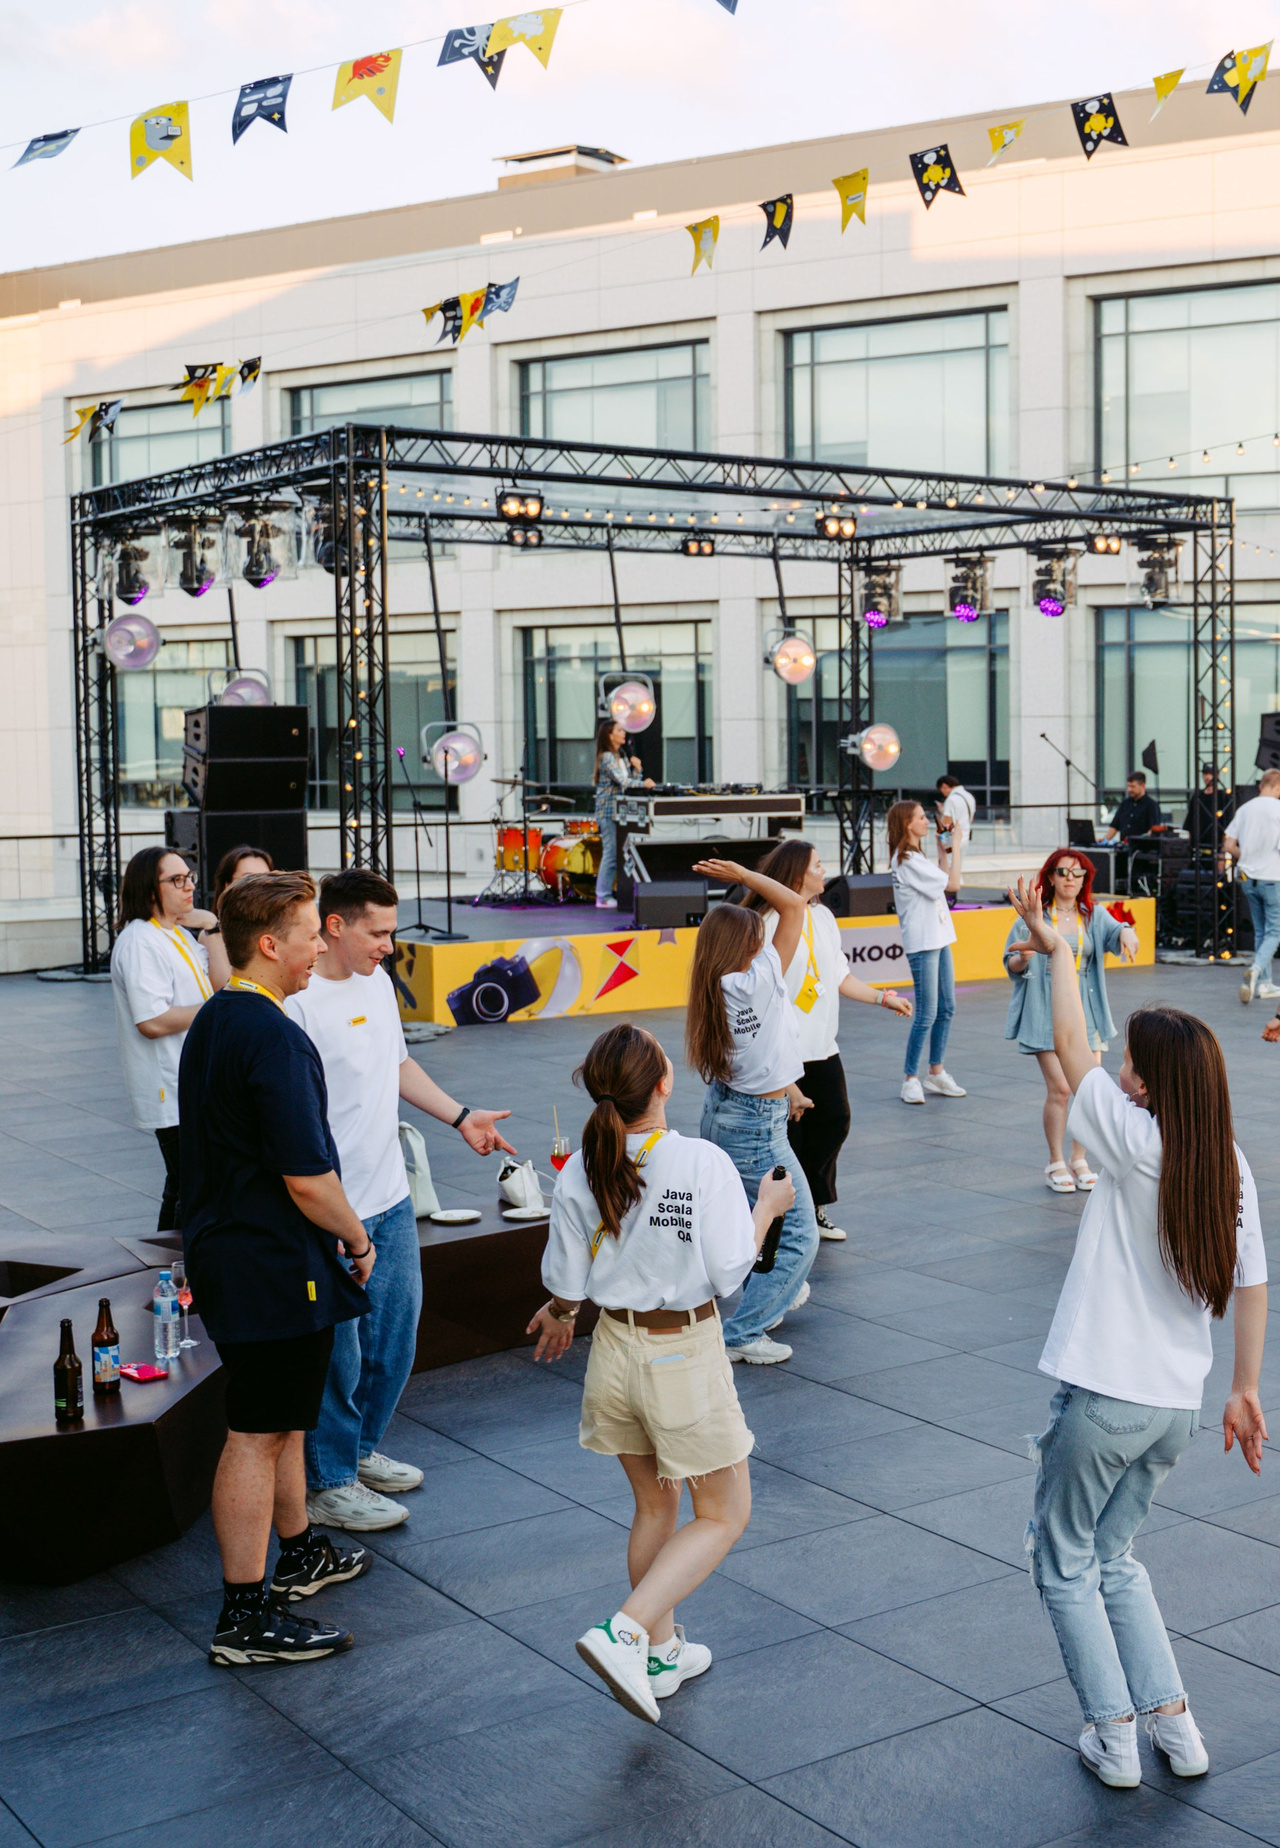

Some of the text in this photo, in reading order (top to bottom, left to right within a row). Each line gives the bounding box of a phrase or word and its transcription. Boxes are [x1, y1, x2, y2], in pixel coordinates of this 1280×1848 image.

[736, 1007, 754, 1017] Java
[736, 1015, 758, 1026] Scala
[734, 1023, 761, 1035] Mobile
[662, 1188, 693, 1202] Java
[657, 1202, 693, 1216] Scala
[649, 1215, 693, 1230] Mobile
[1236, 1217, 1244, 1229] A
[677, 1230, 693, 1243] QA
